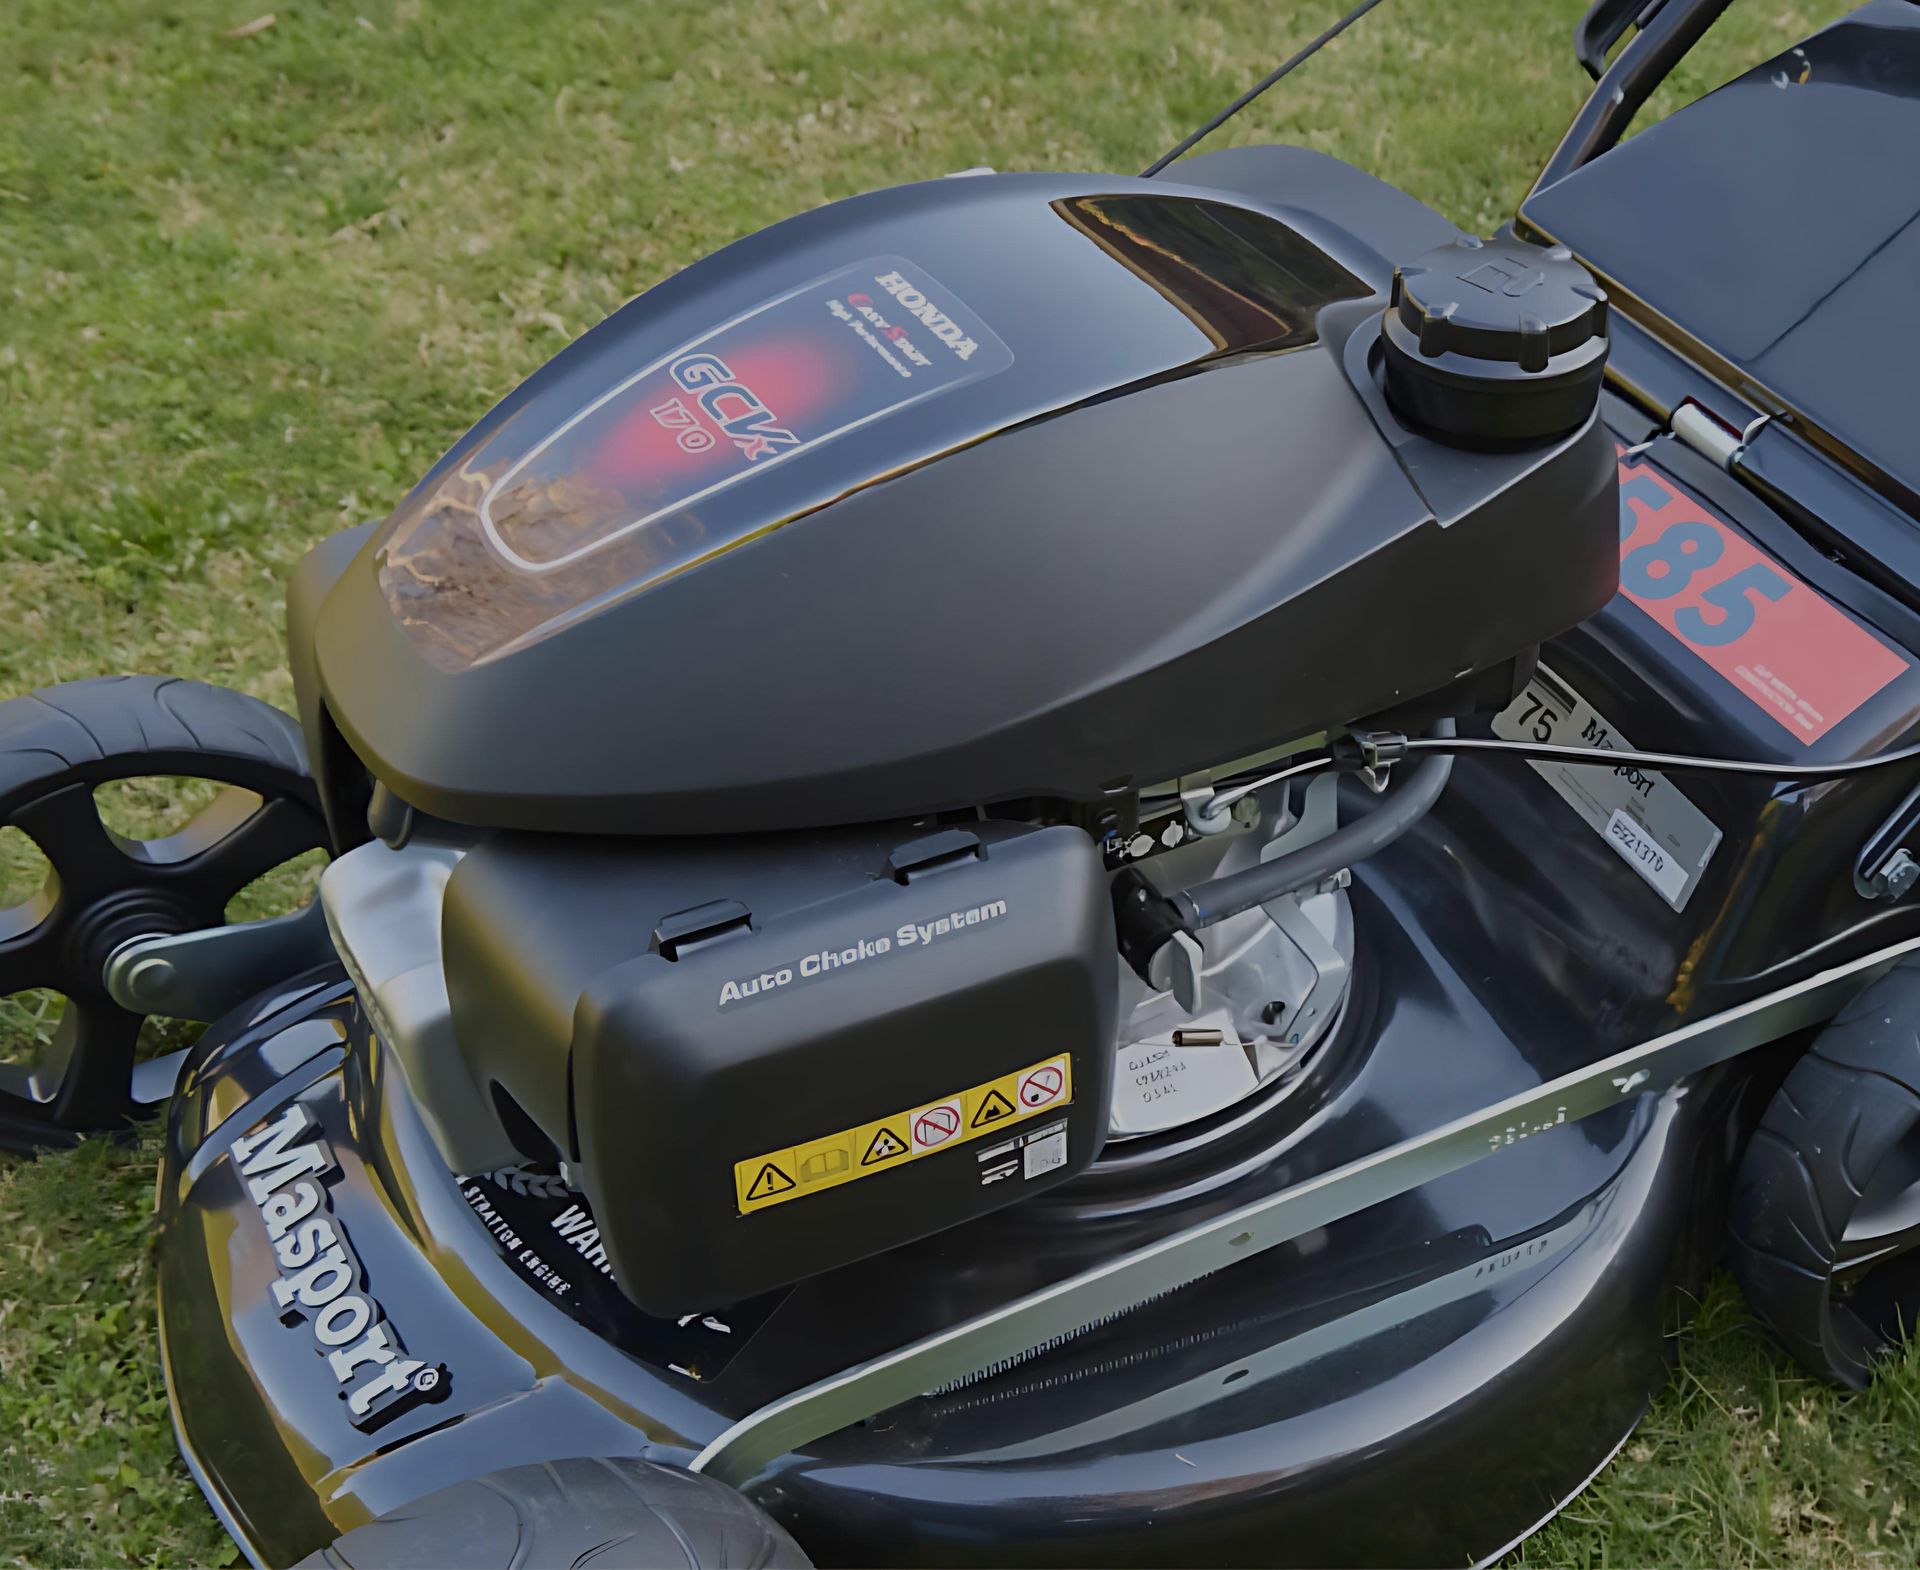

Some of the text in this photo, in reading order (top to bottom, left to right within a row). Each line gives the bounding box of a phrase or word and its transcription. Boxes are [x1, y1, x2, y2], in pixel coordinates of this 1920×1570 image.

[875, 271, 978, 361] HONDA
[650, 398, 716, 453] 170
[719, 968, 793, 1006] Auto
[231, 1104, 428, 1416] Masport
